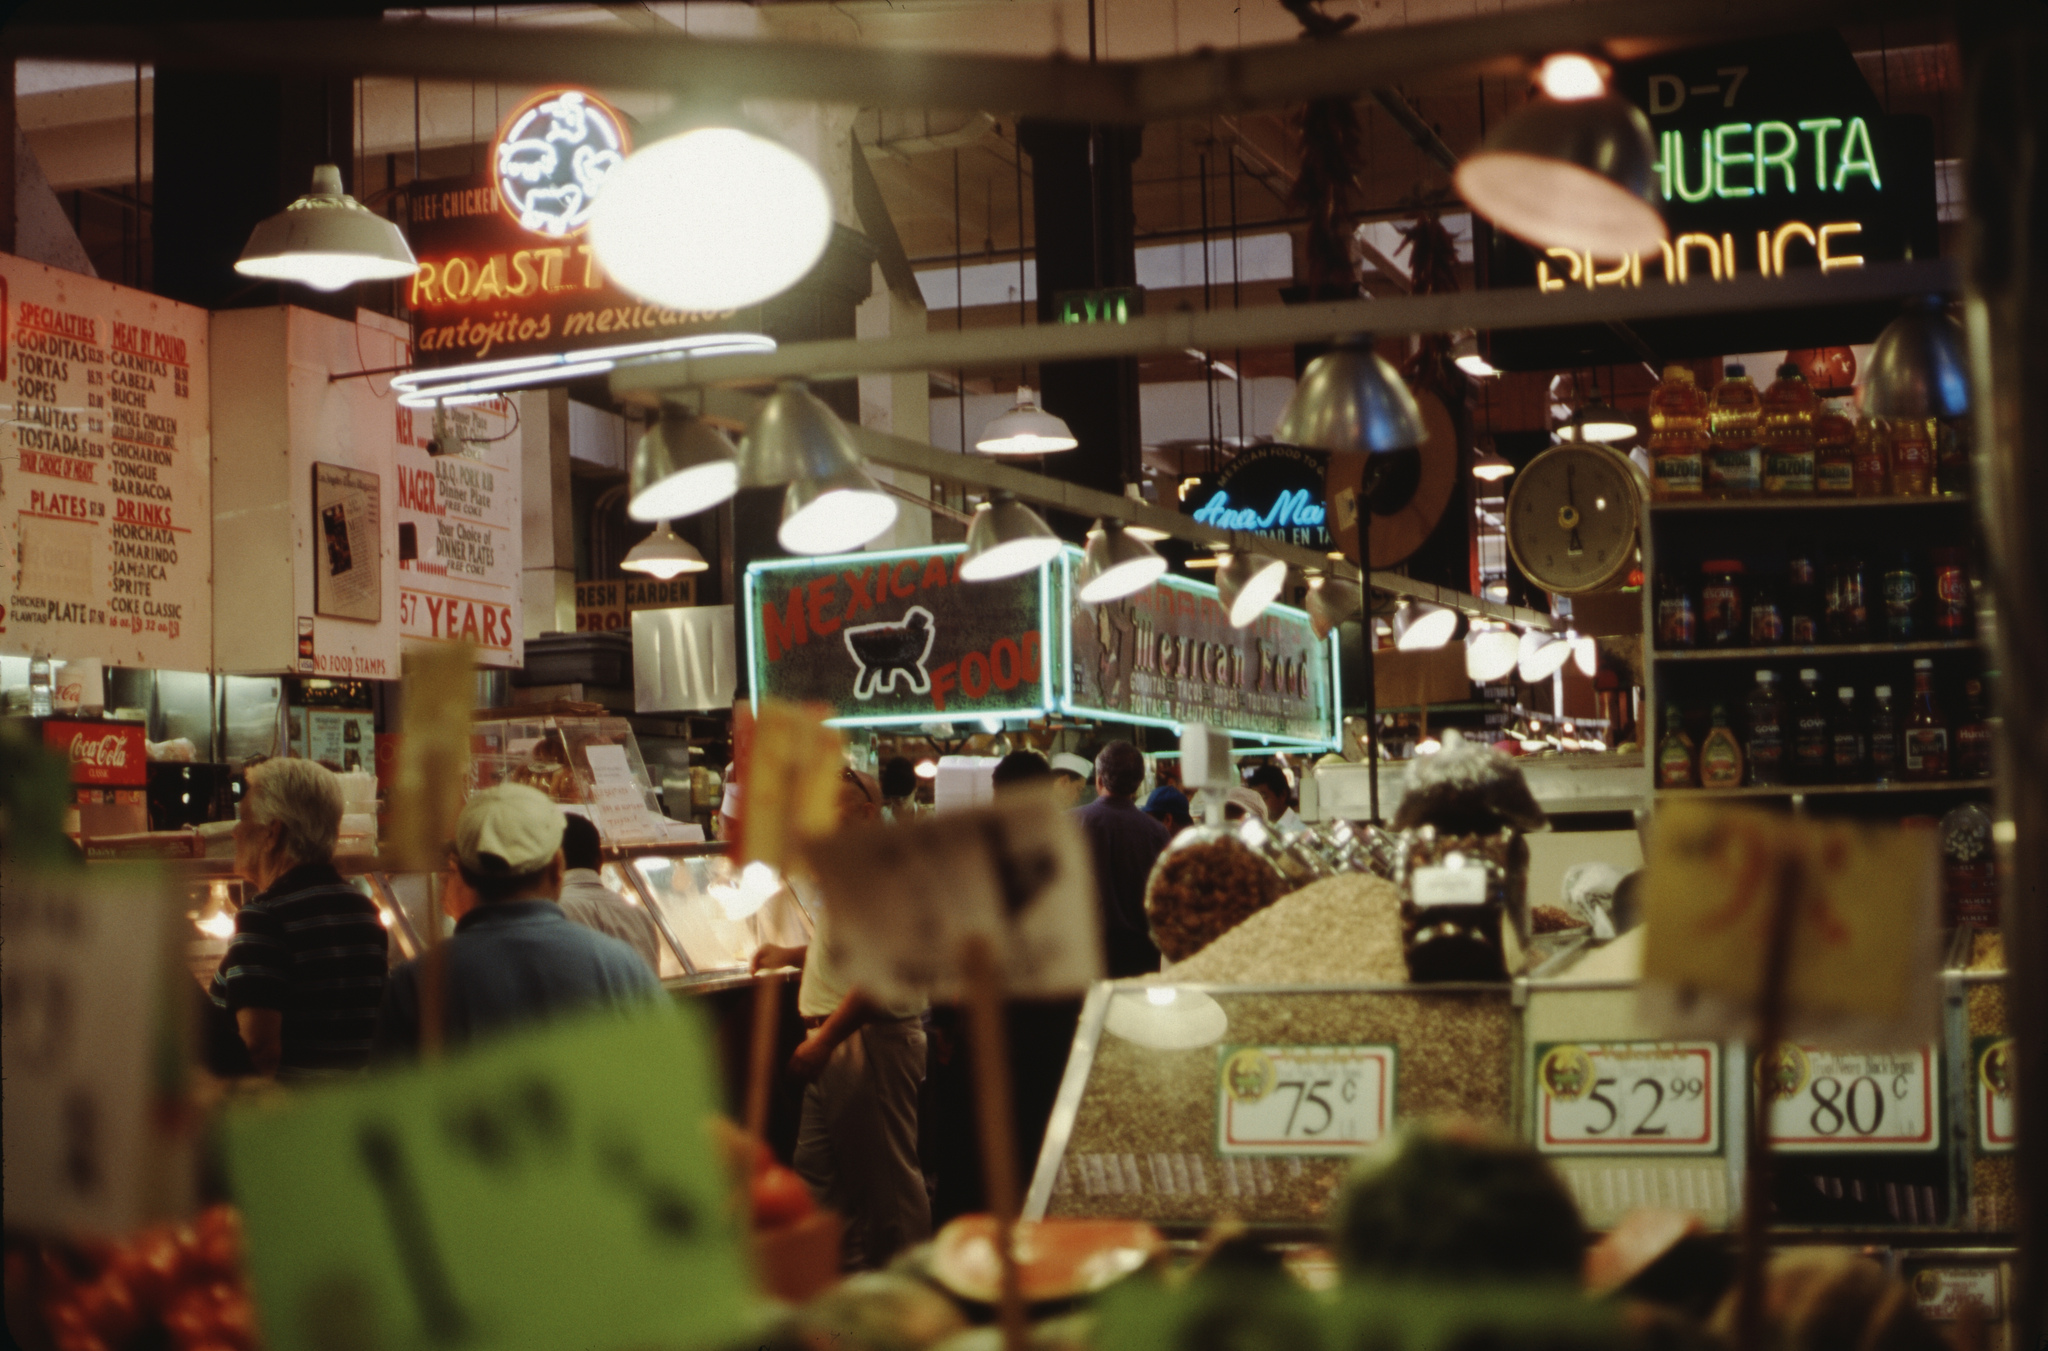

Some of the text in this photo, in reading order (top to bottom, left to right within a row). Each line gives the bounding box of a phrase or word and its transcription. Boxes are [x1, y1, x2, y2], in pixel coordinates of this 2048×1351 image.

[1648, 65, 1749, 115] D-7
[411, 246, 571, 306] ROAST
[20, 302, 95, 339] SPECIALTIES
[17, 329, 88, 364] GORDITAS
[113, 321, 186, 362] MEAT BY POUND
[419, 311, 551, 358] antojitos
[17, 352, 68, 382] TORTAS
[111, 351, 167, 378] CARNITAS
[17, 376, 57, 404] SOPES
[111, 369, 156, 393] CABEZA
[111, 387, 147, 409] BUCHE
[17, 401, 78, 433] FLAUTAS
[112, 406, 177, 434] WHOLE CHICKEN
[111, 442, 172, 467] CHICHARRON
[1767, 457, 1813, 476] Mazola
[113, 460, 157, 482] TONGUE
[1655, 459, 1701, 477] Mazola
[112, 478, 172, 501] BARBACOA
[439, 481, 491, 508] Dinner Plate
[31, 489, 86, 517] PLATES
[116, 498, 171, 525] DRINKS
[463, 503, 482, 517] COKE
[112, 523, 175, 546] HORCHATA
[437, 519, 454, 537] Your
[456, 523, 481, 544] Choice
[1293, 527, 1310, 546] EN
[112, 540, 178, 565] TAMARINDO
[436, 536, 495, 567] DINNER PLATES
[112, 561, 167, 581] JAMAICA
[466, 563, 485, 576] COKE
[112, 577, 151, 596] SPRITE
[577, 581, 690, 608] RESH GARDEN
[11, 595, 46, 608] CHICKEN
[47, 600, 86, 624] PLATE
[111, 597, 181, 619] COKE CLASSIC
[400, 592, 512, 648] 57 YEARS
[313, 655, 386, 676] NO FOOD STAMPS
[929, 630, 1041, 711] FOOD
[1755, 724, 1780, 734] GOYA
[1799, 719, 1827, 729] GOYA
